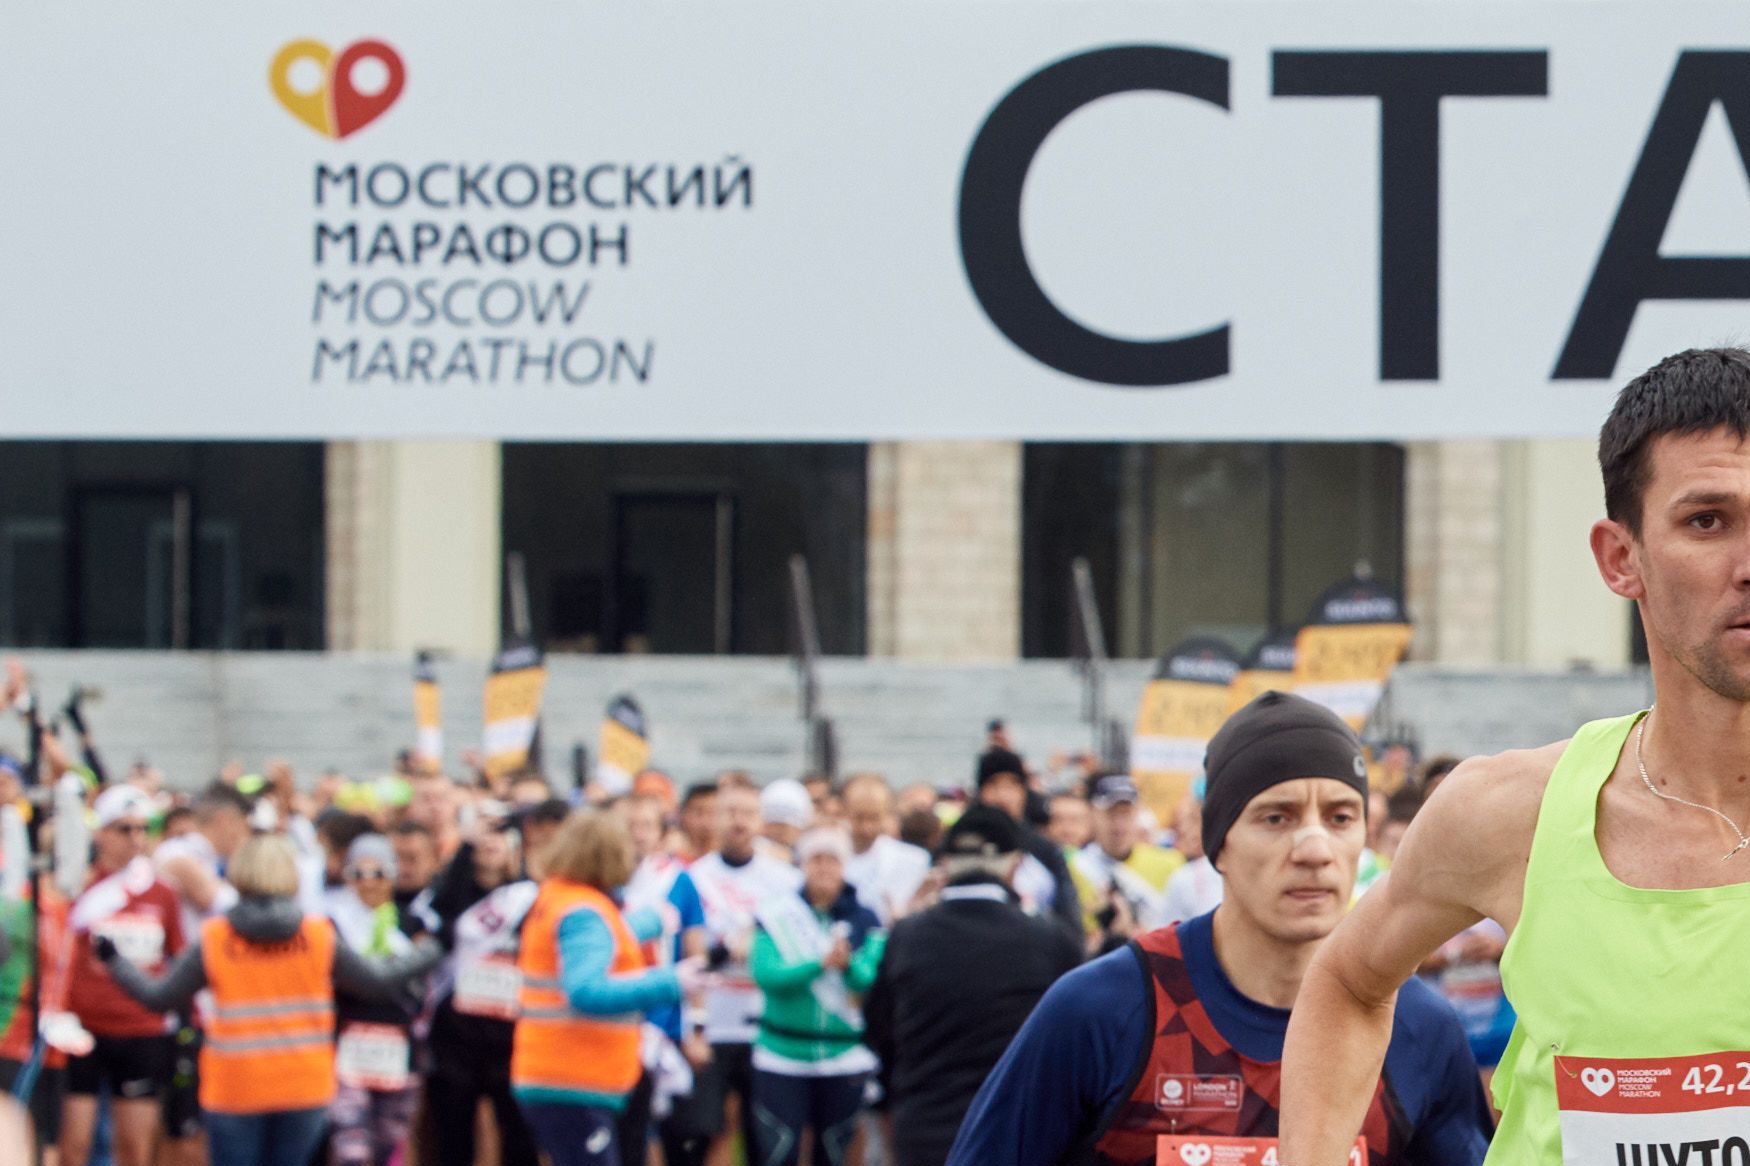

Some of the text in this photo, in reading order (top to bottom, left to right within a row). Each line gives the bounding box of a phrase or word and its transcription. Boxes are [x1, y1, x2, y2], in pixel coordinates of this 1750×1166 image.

[313, 155, 754, 210] МОСКОВСКИЙ
[313, 221, 630, 268] МАРАФОН
[312, 278, 592, 328] MOSCOW
[311, 337, 656, 386] MARATHON
